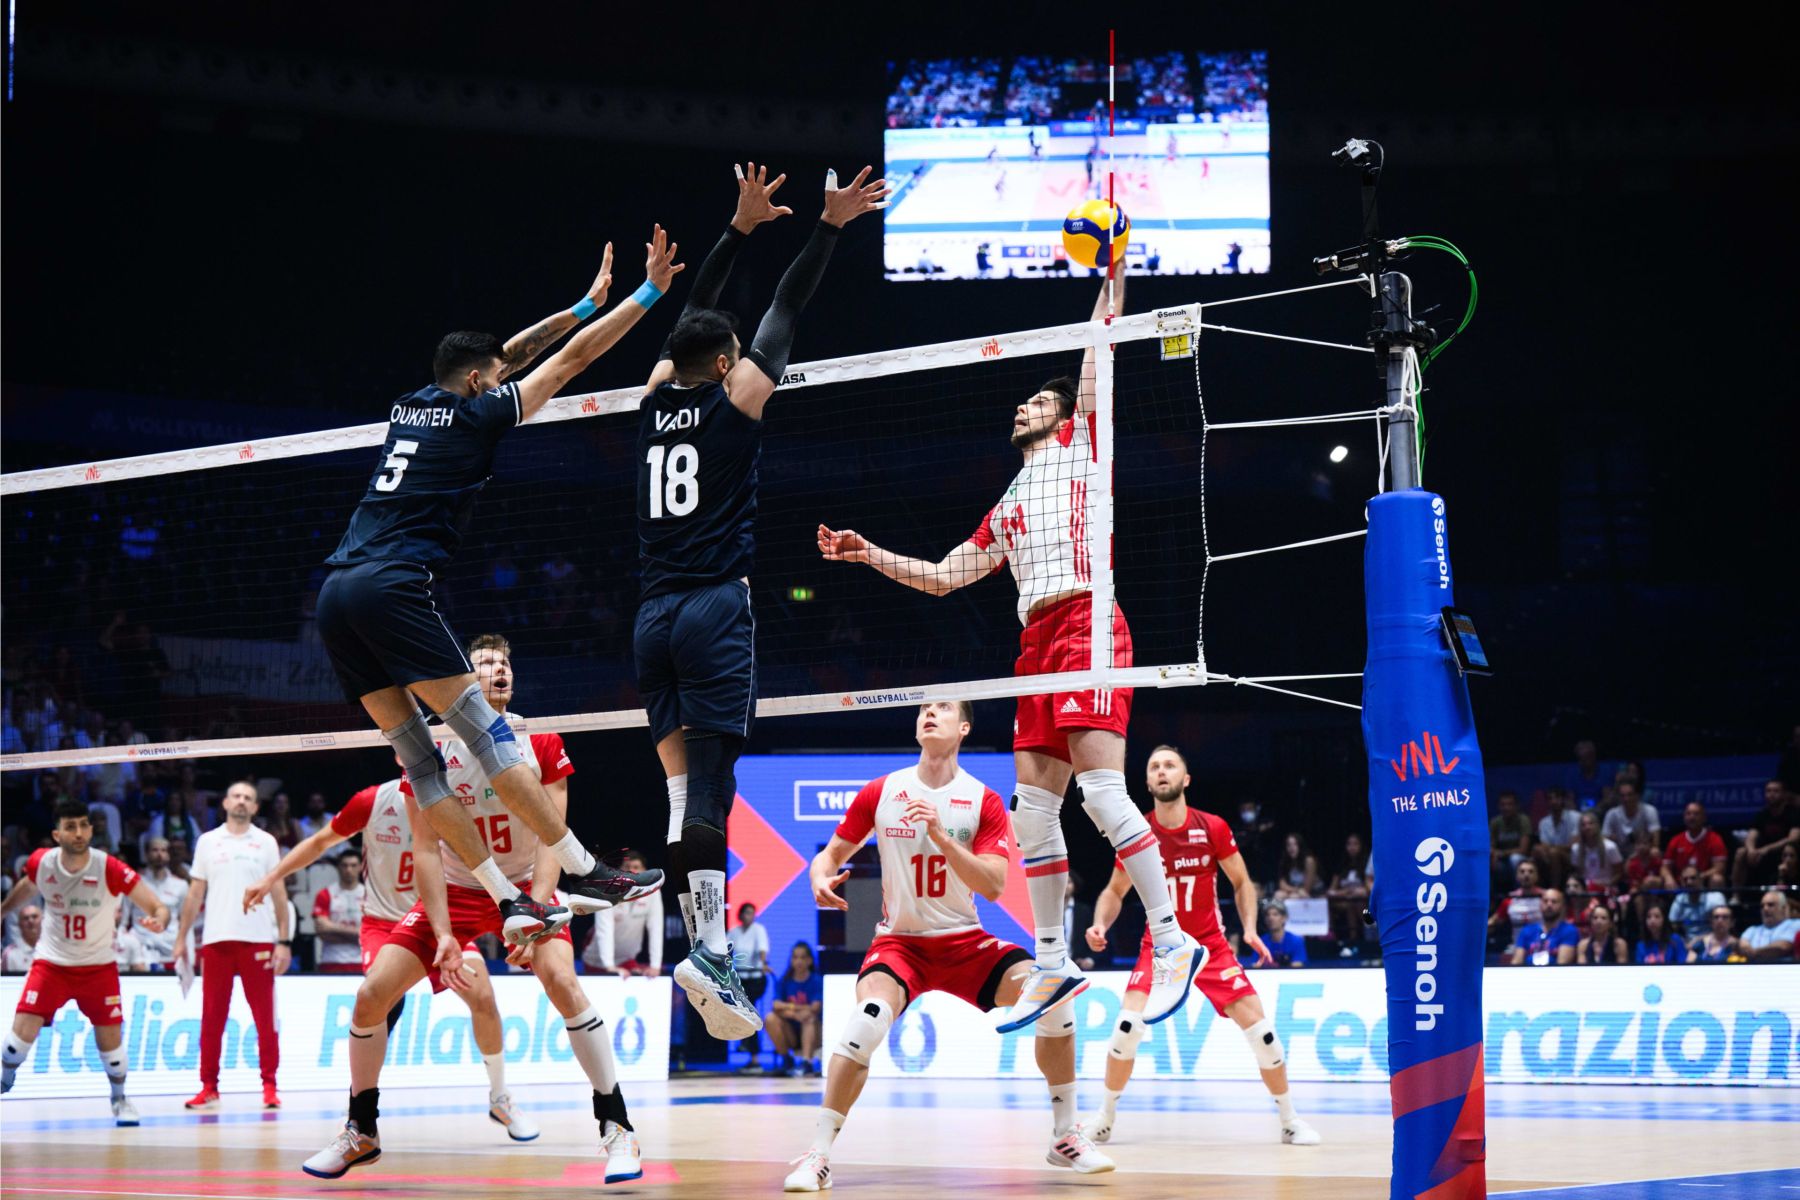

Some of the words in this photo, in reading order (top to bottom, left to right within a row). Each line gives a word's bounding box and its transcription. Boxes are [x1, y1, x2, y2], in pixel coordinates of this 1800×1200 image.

[1163, 310, 1187, 318] Senoh
[981, 339, 1003, 358] VNL
[581, 396, 600, 413] VNL
[655, 407, 700, 432] VADI
[375, 440, 419, 492] 5
[646, 443, 699, 519] 18
[1434, 518, 1450, 589] Senoh
[855, 693, 909, 704] VOLLEYBALL
[138, 746, 177, 756] VOLLEYBALL
[1391, 731, 1460, 782] VNL
[1392, 795, 1418, 814] THE
[1423, 788, 1470, 809] FINALS
[473, 814, 513, 854] 15
[887, 829, 915, 838] ORLEN
[1174, 856, 1200, 870] plus
[911, 854, 947, 898] 16
[1166, 875, 1196, 912] 17
[63, 915, 87, 940] 19
[401, 912, 421, 927] 15
[1415, 882, 1449, 1031] Senoh
[1130, 971, 1145, 985] 17
